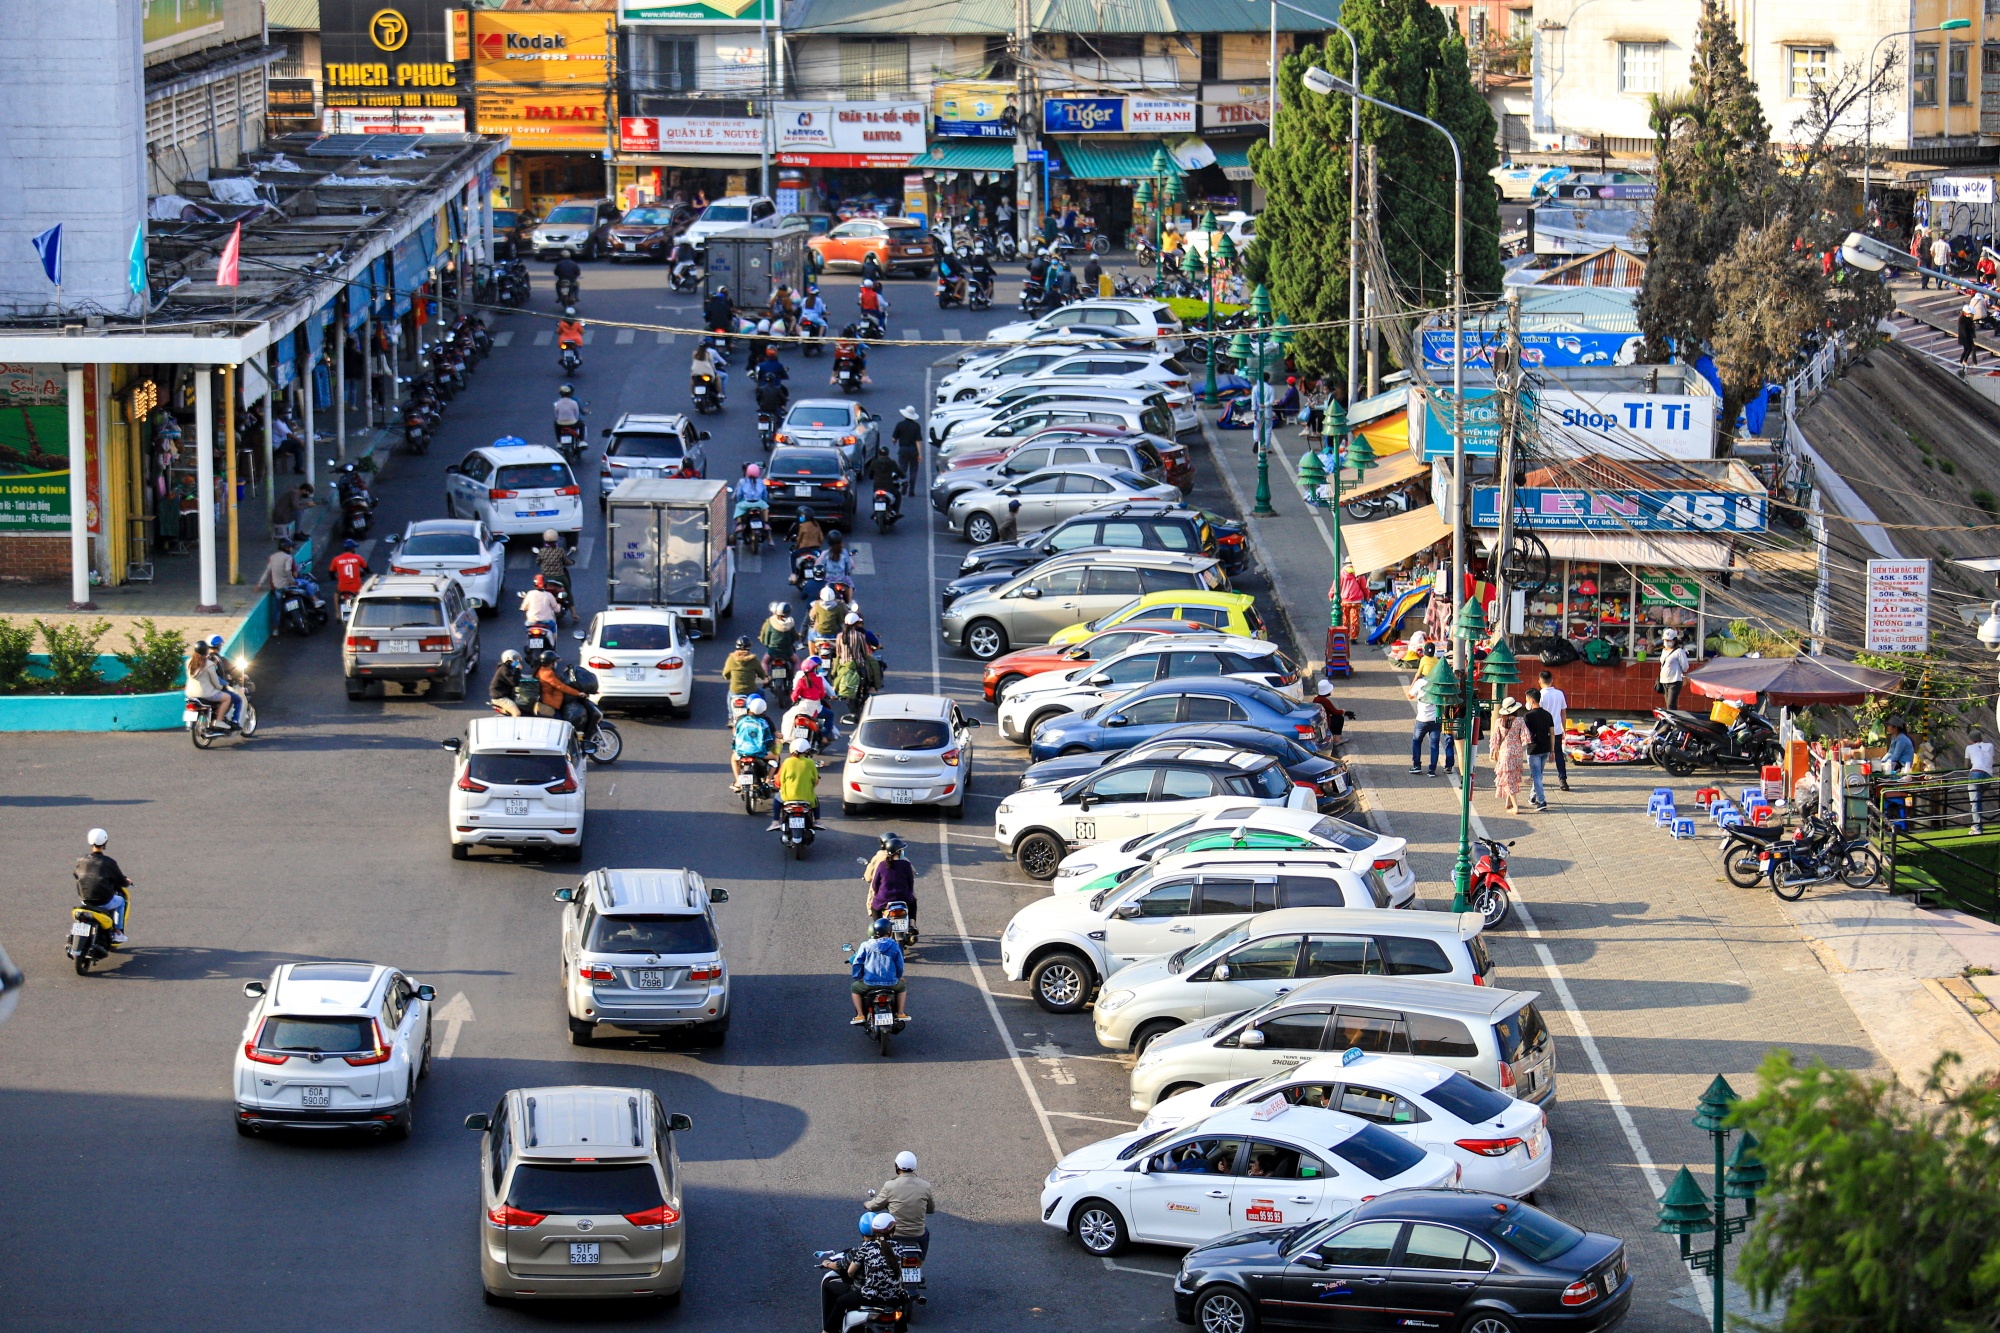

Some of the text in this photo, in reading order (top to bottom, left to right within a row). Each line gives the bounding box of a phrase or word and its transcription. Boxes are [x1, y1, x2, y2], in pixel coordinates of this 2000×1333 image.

[640, 10, 704, 18] www.vinalatex.com
[506, 33, 566, 49] Kodak
[506, 53, 568, 62] express
[524, 106, 599, 120] DALAT
[1065, 103, 1113, 129] Tiger
[1133, 110, 1191, 124] MỸ HẠNH
[478, 126, 513, 134] Digital
[863, 131, 902, 141] HANVICO
[1562, 402, 1690, 432] Shop Ti Ti
[6, 486, 36, 494] LONG
[1076, 822, 1094, 839] 80
[308, 1088, 323, 1096] 60A
[304, 1097, 329, 1106] 590.06
[1260, 1211, 1266, 1220] 95
[1267, 1212, 1273, 1221] 95
[1274, 1212, 1280, 1221] 95
[576, 1244, 592, 1253] 51F
[571, 1254, 599, 1263] 528.39
